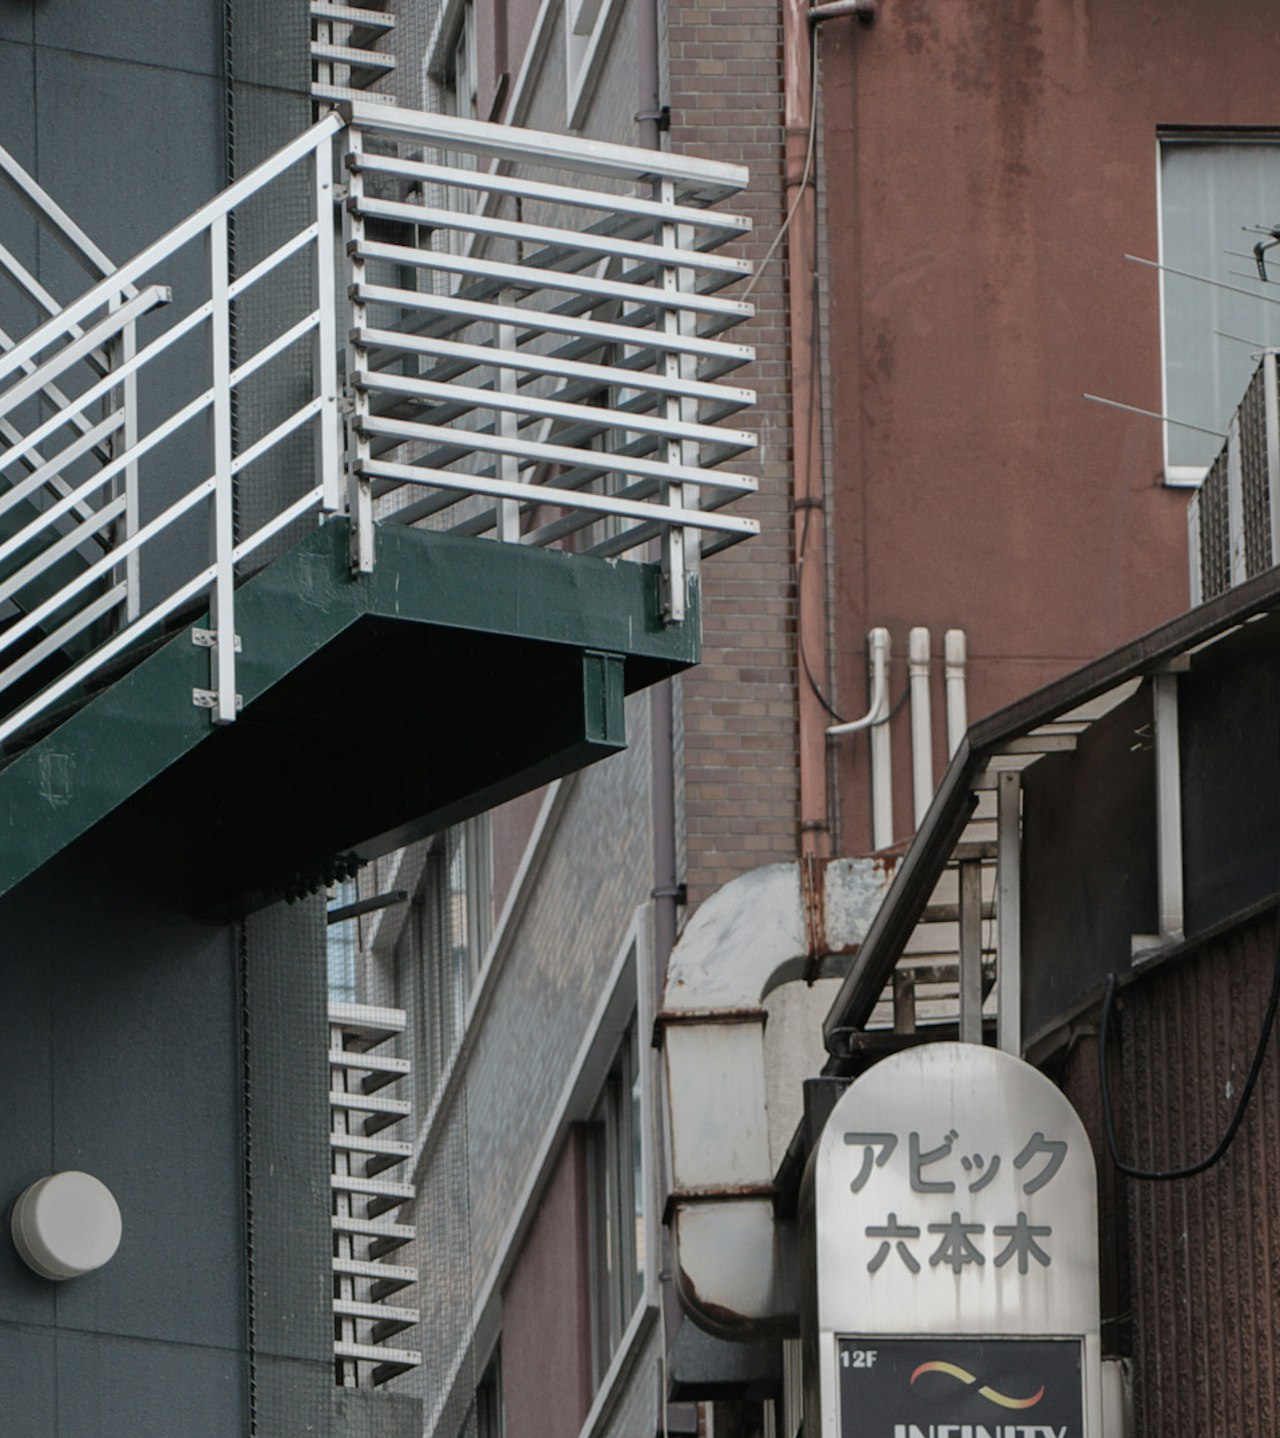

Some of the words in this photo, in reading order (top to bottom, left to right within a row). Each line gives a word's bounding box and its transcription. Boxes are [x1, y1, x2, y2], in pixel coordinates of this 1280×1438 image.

[843, 1129, 1069, 1195] アビック
[865, 1211, 1052, 1275] 六本木
[840, 1350, 877, 1368] 12F
